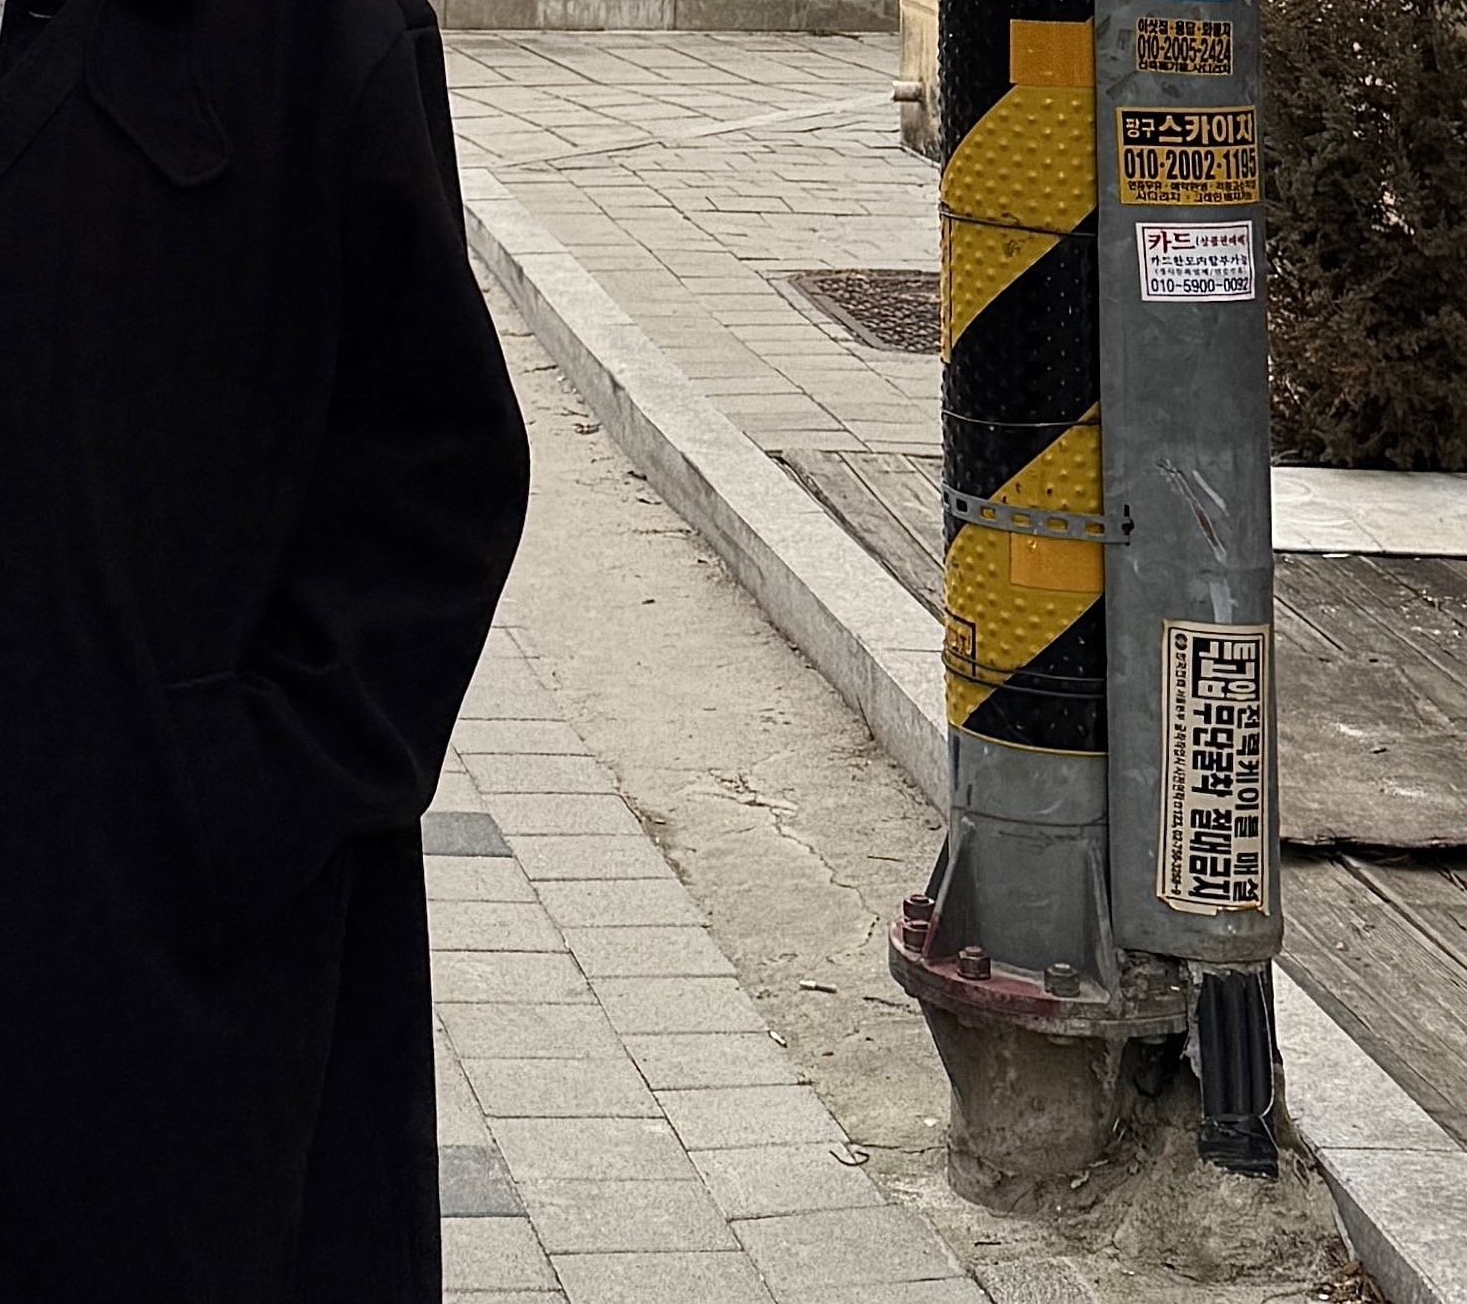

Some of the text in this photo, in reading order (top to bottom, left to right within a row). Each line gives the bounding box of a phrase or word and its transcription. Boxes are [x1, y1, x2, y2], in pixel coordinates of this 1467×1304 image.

[1147, 230, 1196, 254] 카드
[1197, 640, 1258, 700] 특고압
[1188, 702, 1235, 901] 무단굴착 절대금지
[1233, 704, 1261, 902] 전력케이블 매설
